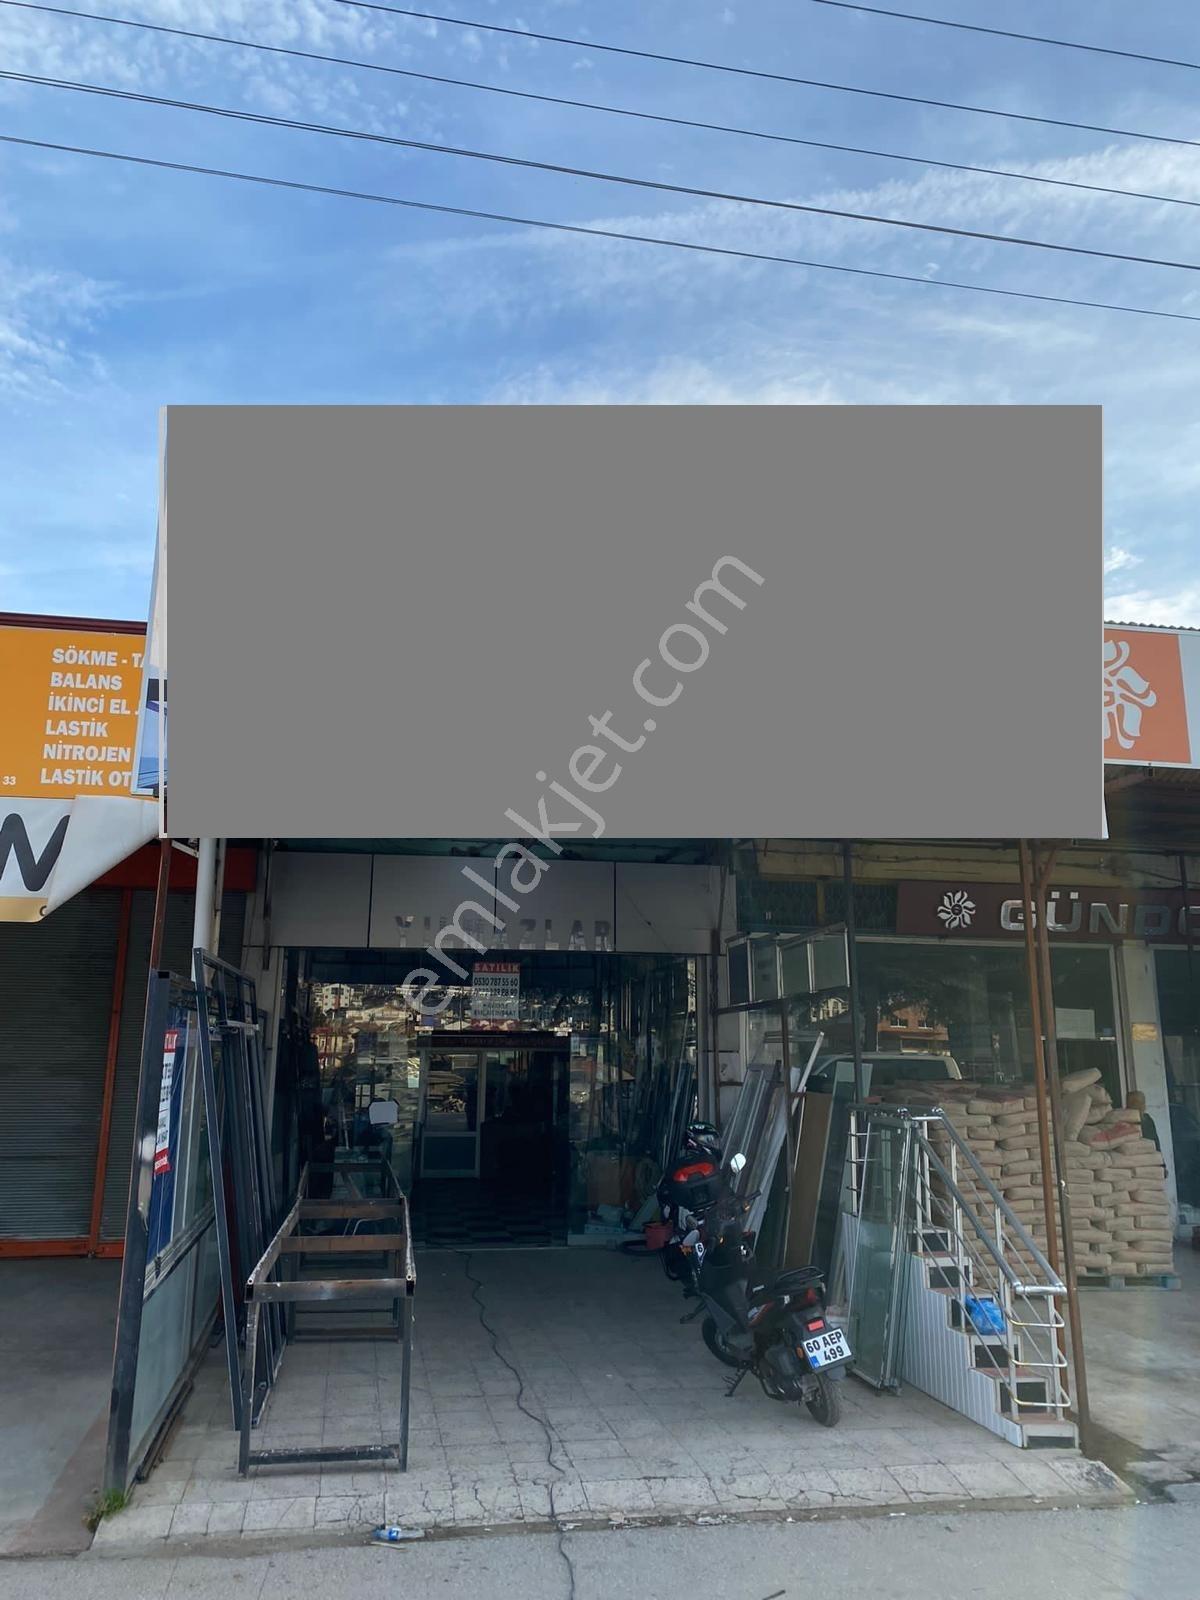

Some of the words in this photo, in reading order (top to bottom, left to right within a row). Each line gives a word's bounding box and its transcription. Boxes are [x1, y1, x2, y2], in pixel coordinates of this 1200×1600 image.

[52, 645, 118, 667] SÖKME
[132, 652, 145, 668] T
[50, 671, 122, 690] BALANS
[48, 691, 105, 713] İKİNCİ
[109, 698, 131, 714] EL
[45, 717, 108, 737] LASTİK
[43, 740, 131, 762] NİTROJEN
[40, 765, 103, 786] LASTİK
[805, 1339, 821, 1354] 60
[821, 1331, 842, 1348] AEP
[823, 1345, 845, 1362] 499
